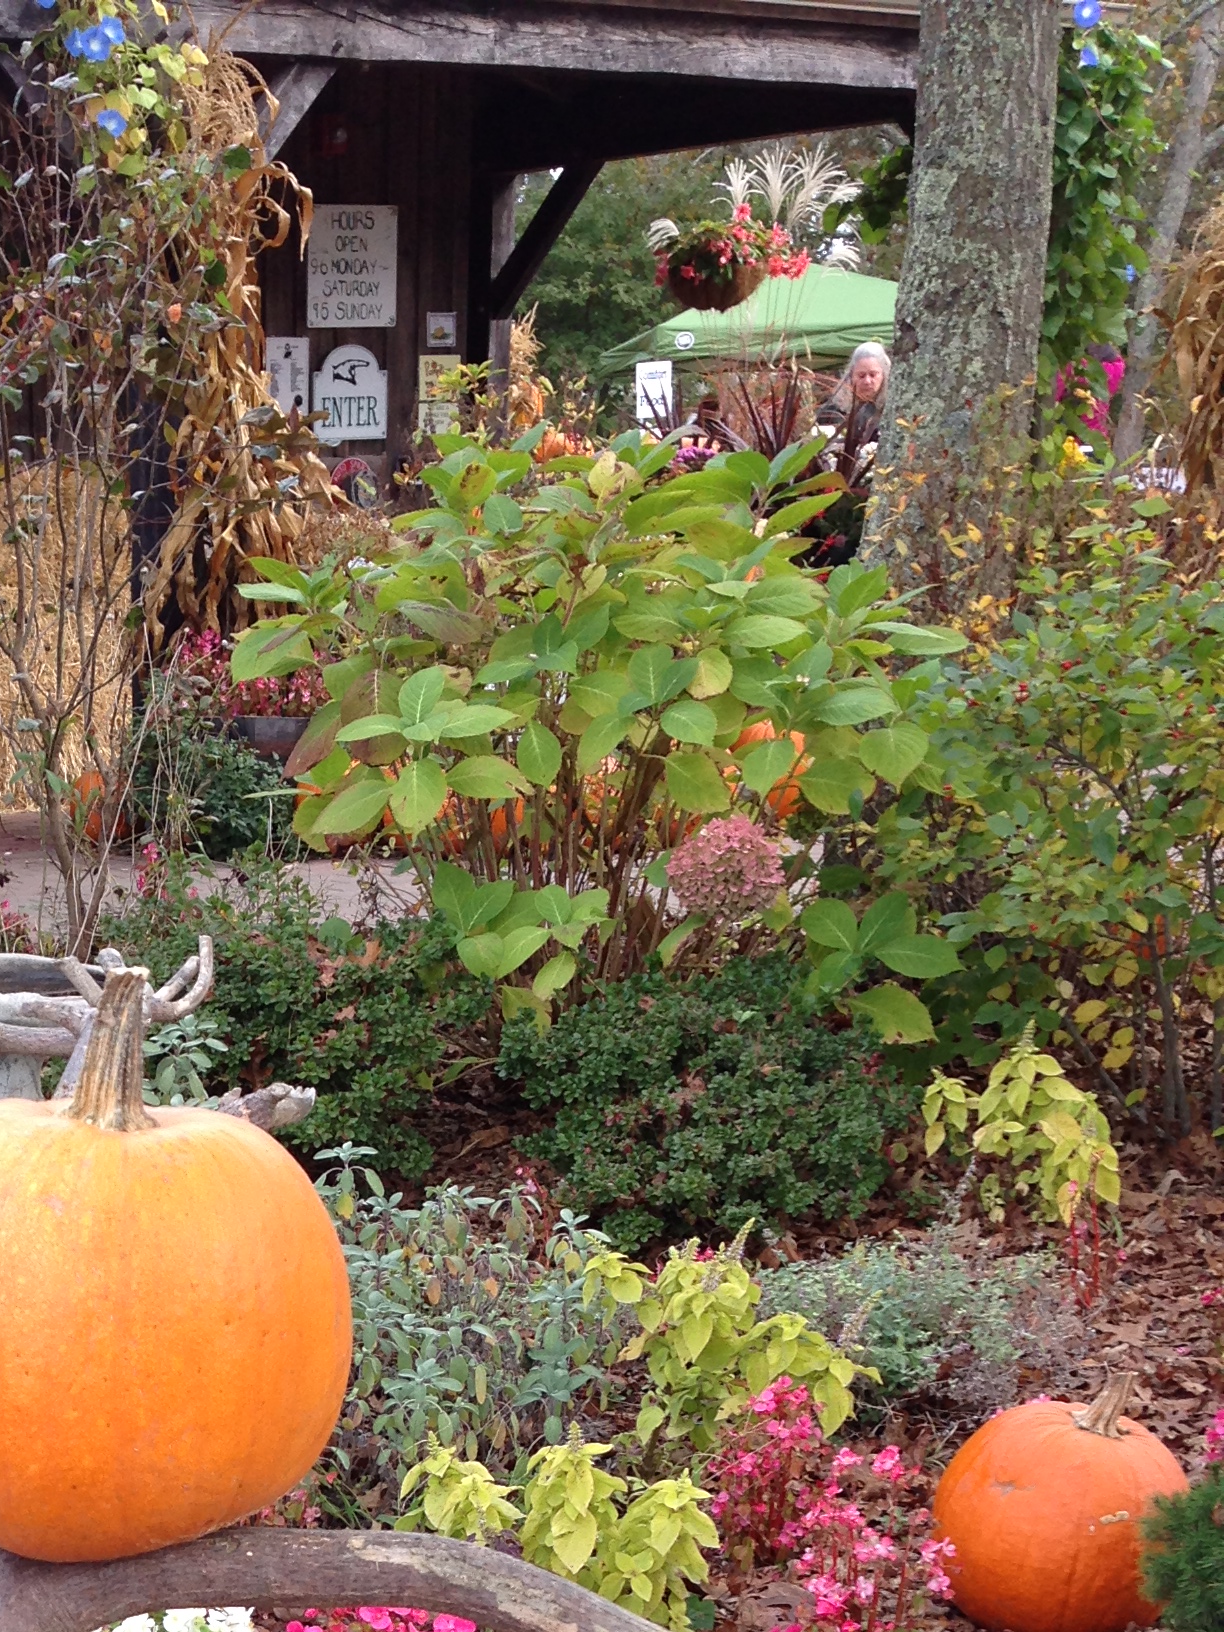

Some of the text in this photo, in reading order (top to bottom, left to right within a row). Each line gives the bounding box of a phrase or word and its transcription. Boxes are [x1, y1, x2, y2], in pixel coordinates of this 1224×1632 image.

[331, 211, 375, 230] HOURS
[335, 235, 368, 252] OPEN
[322, 279, 380, 297] SATURDAY
[334, 301, 383, 320] SUNDAY
[322, 396, 380, 427] ENTER
